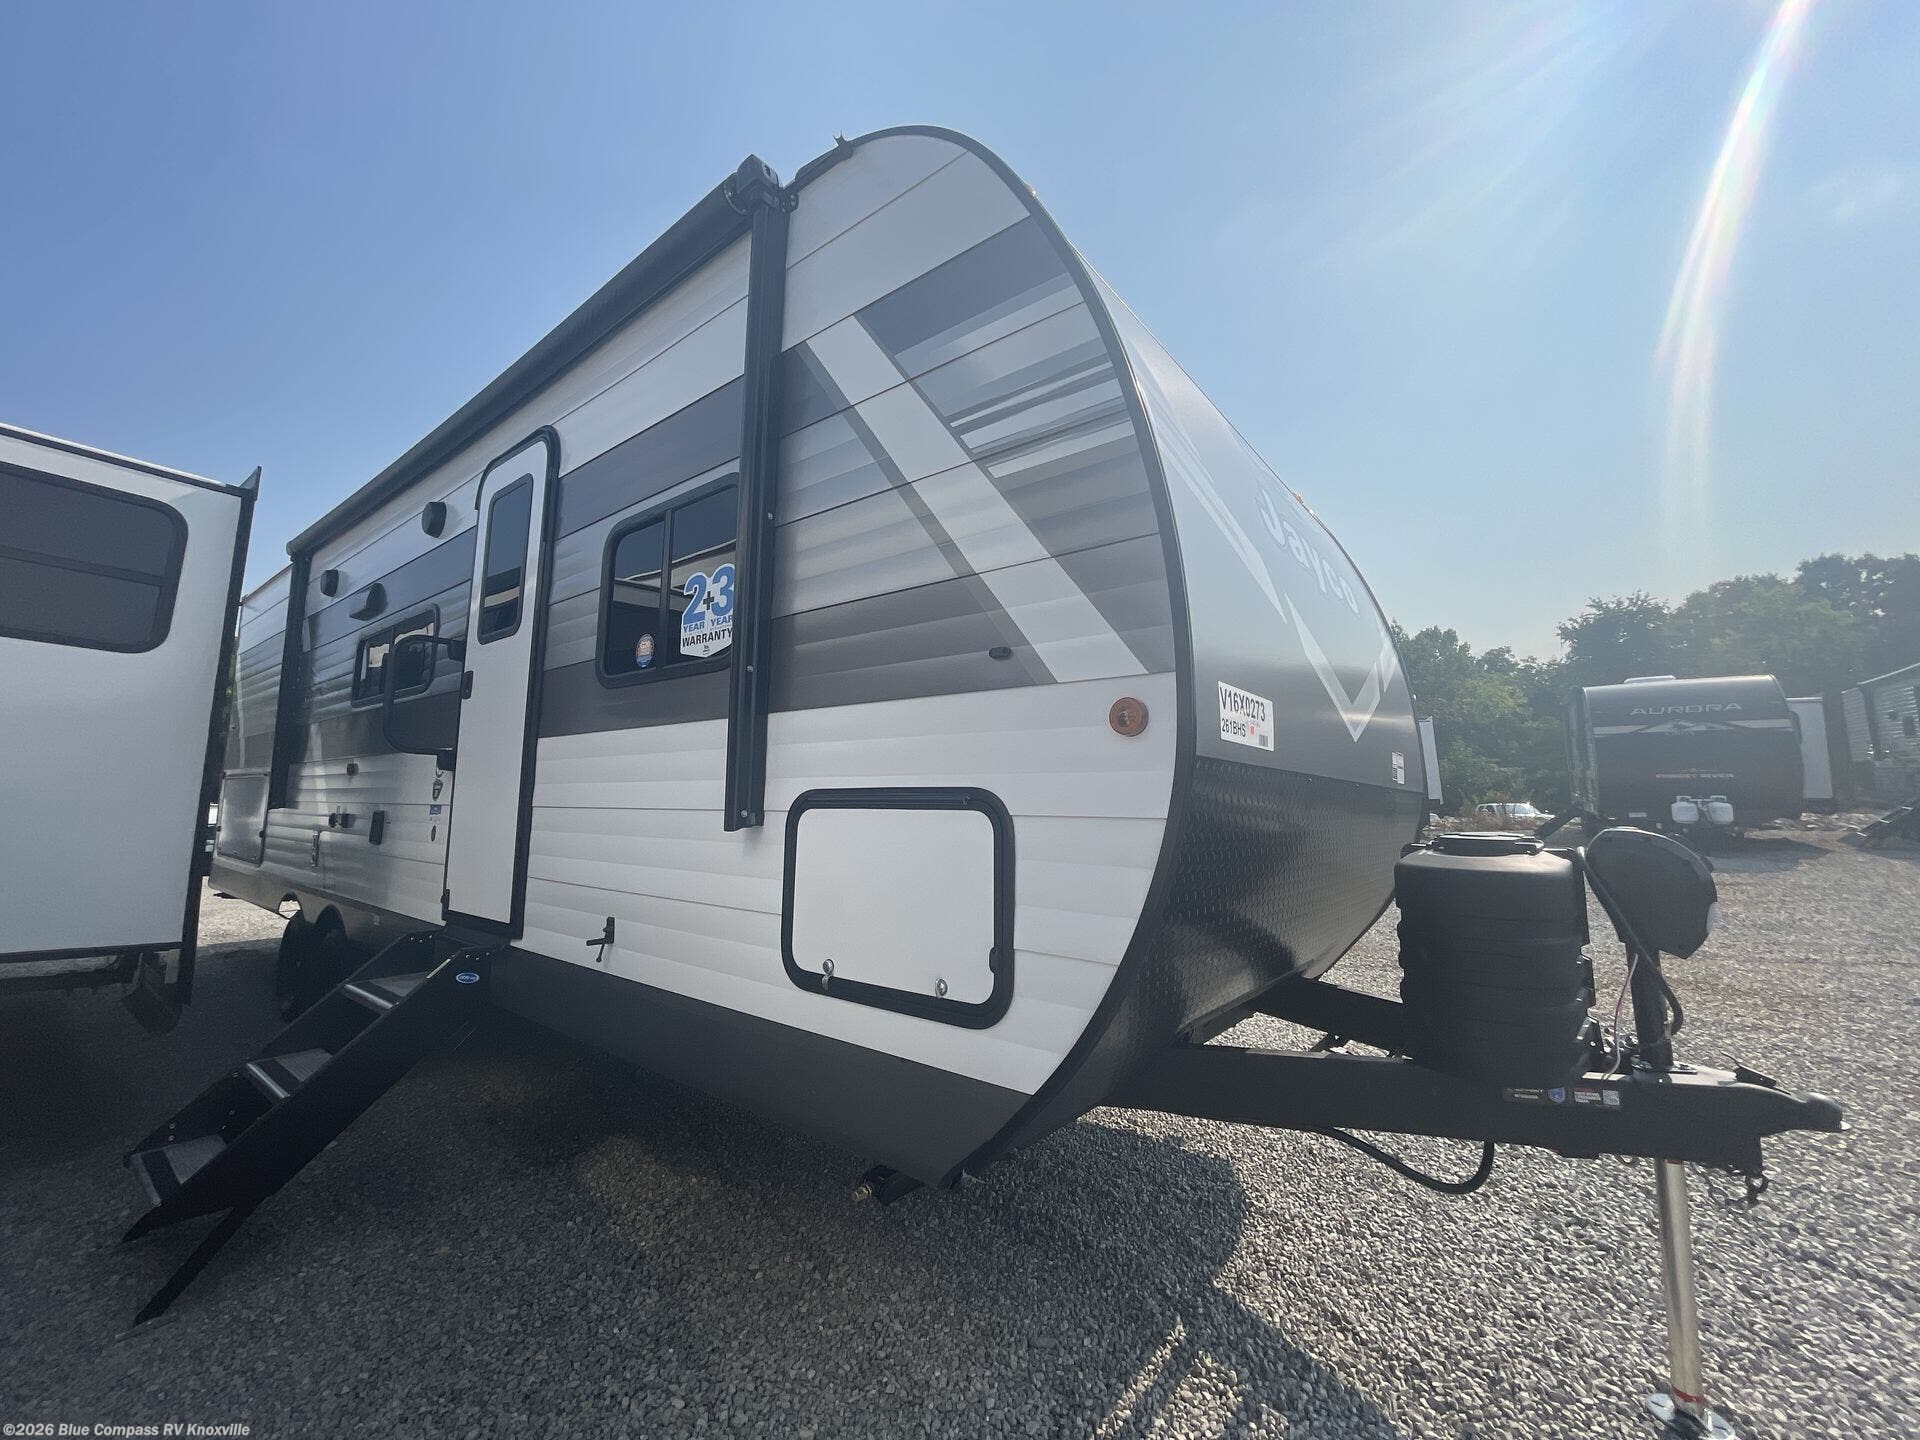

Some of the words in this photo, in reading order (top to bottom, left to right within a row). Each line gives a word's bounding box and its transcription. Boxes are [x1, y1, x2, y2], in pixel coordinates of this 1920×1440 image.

[684, 621, 705, 632] YEAR
[682, 628, 733, 647] WARRANTY
[1220, 686, 1265, 722] V16X0273
[1630, 703, 1742, 715] AURORA
[1222, 718, 1246, 737] 261BHS
